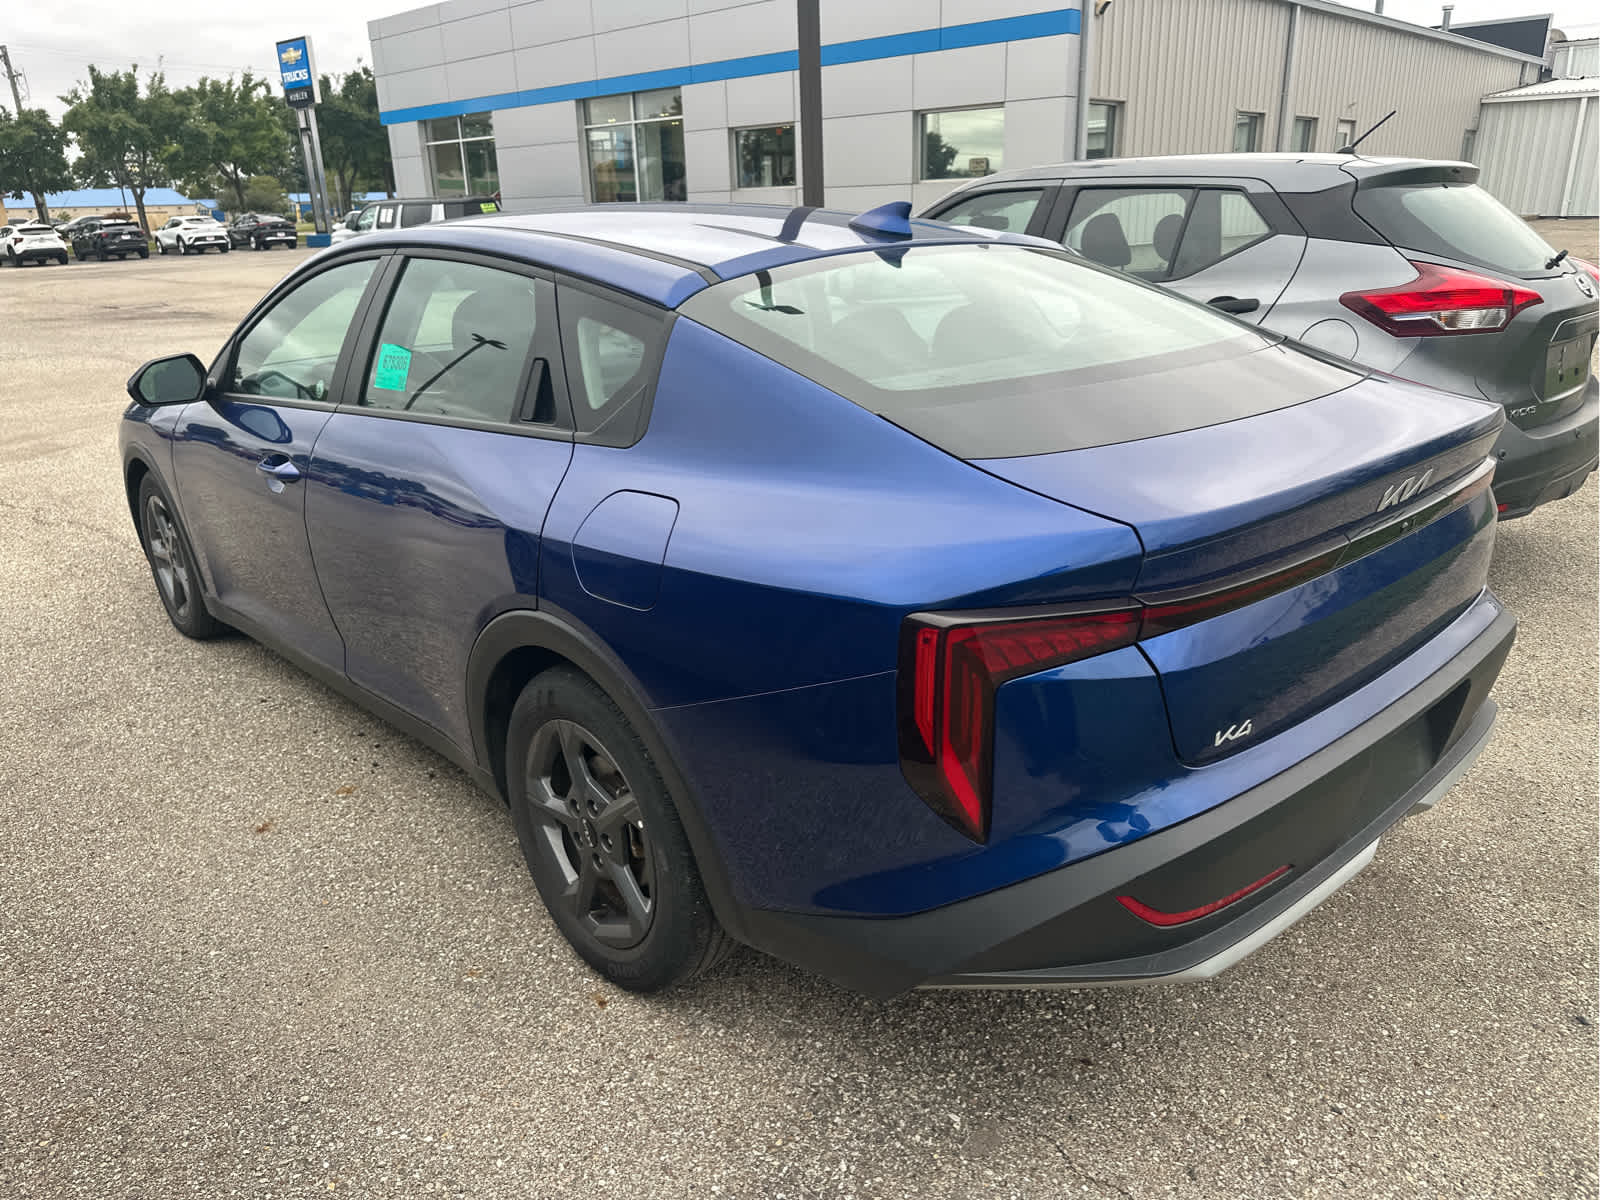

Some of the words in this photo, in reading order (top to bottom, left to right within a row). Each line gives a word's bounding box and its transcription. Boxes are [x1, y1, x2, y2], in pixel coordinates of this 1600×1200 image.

[282, 69, 308, 83] TRUCKS
[1377, 468, 1434, 512] KIA
[1214, 719, 1252, 747] K4
